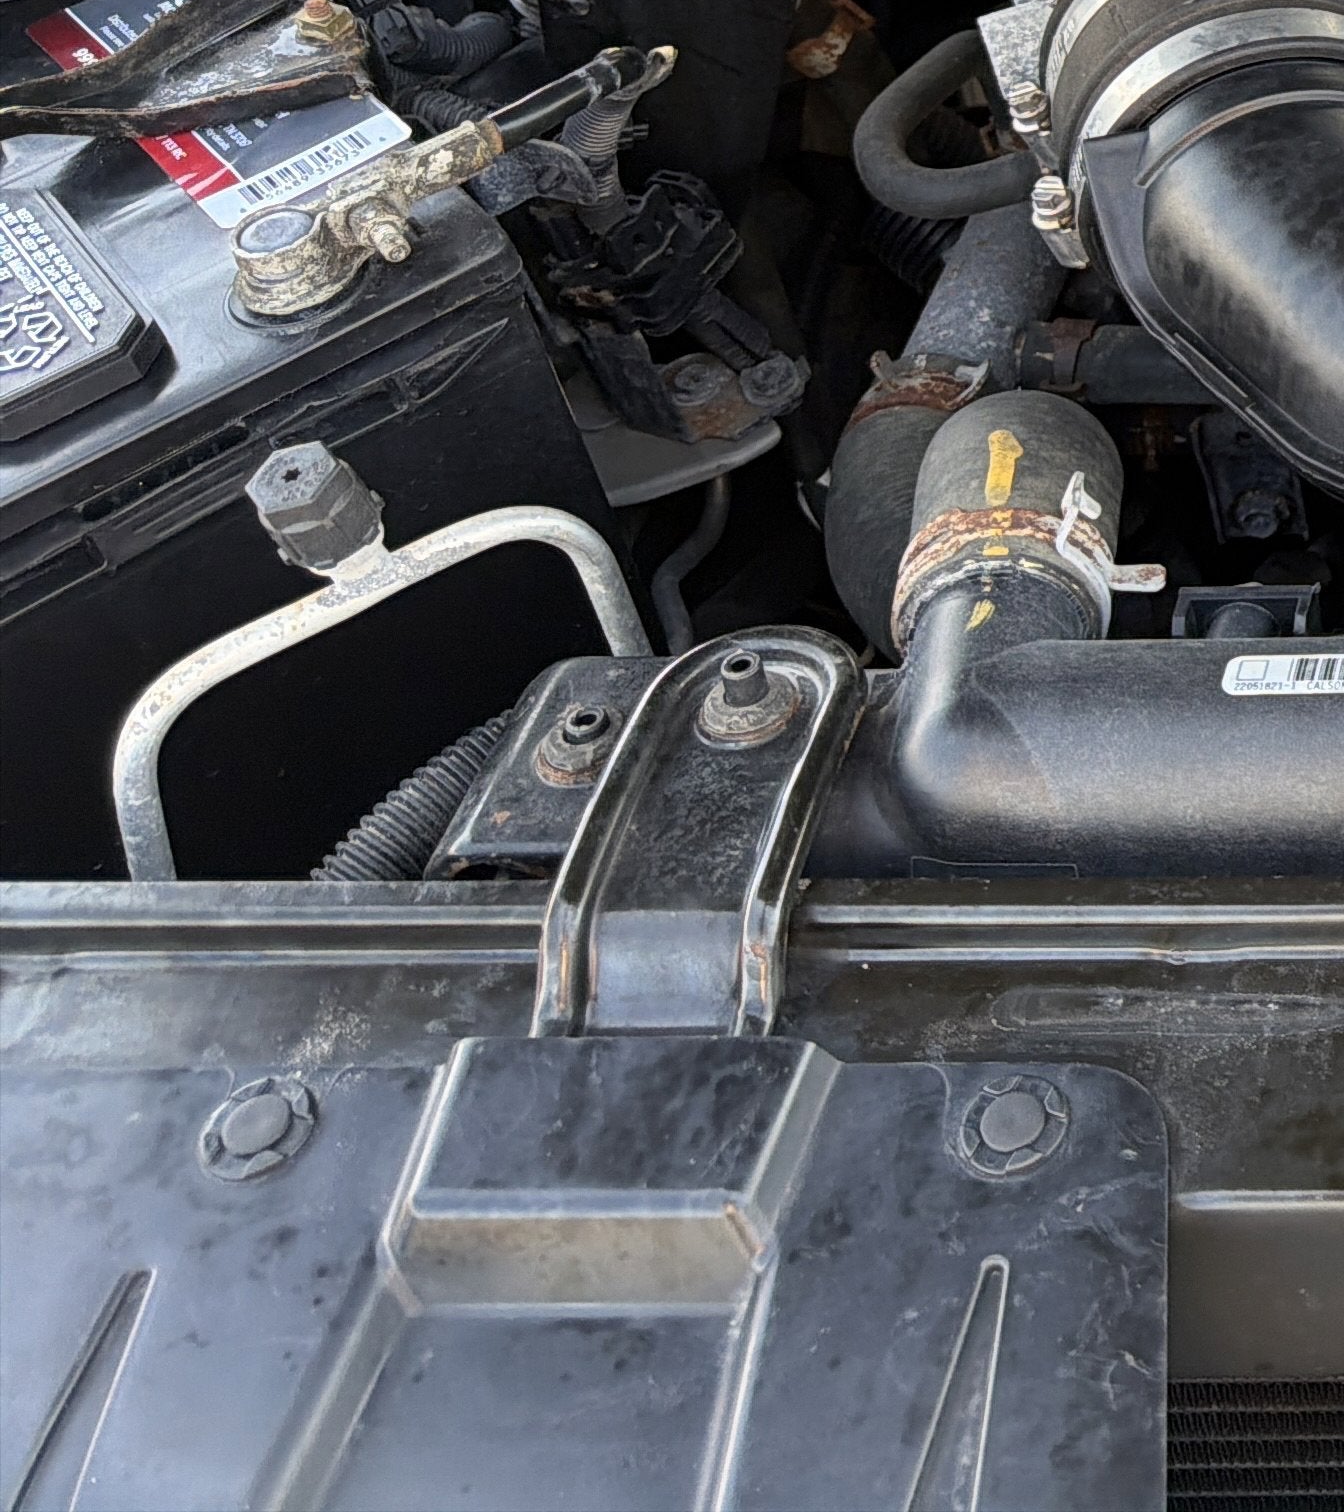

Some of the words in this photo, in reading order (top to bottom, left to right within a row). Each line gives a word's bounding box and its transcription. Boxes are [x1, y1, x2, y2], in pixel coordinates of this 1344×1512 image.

[16, 207, 35, 224] KEEP
[27, 222, 44, 236] OUT
[36, 233, 51, 245] OF
[44, 242, 61, 256] THE
[67, 272, 82, 284] OF
[20, 234, 38, 250] KEEP
[67, 297, 86, 312] AND
